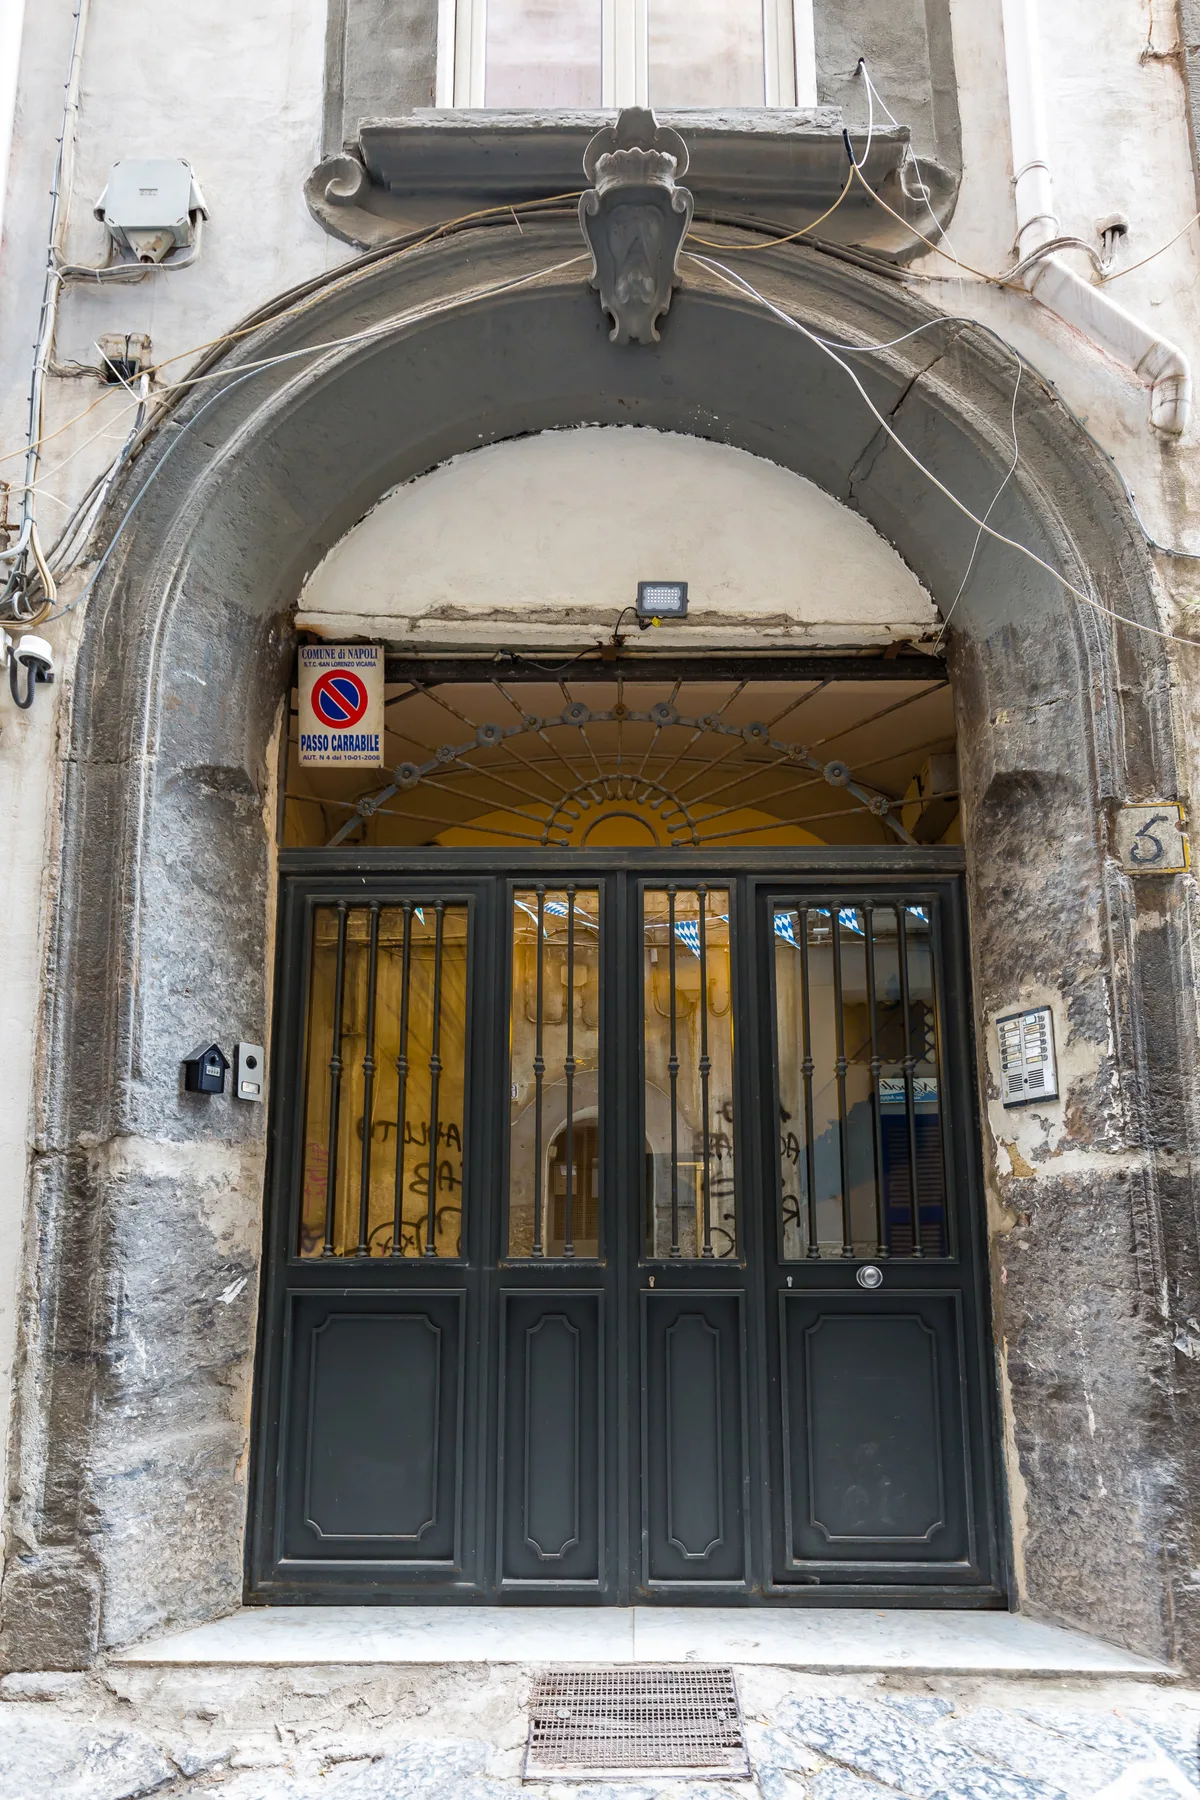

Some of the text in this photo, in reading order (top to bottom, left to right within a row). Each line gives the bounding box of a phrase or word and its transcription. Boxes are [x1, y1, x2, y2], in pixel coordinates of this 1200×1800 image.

[301, 648, 378, 660] COMUNE di NAPOLI
[301, 734, 380, 752] PASSO CARRABILE
[1130, 813, 1169, 864] 5
